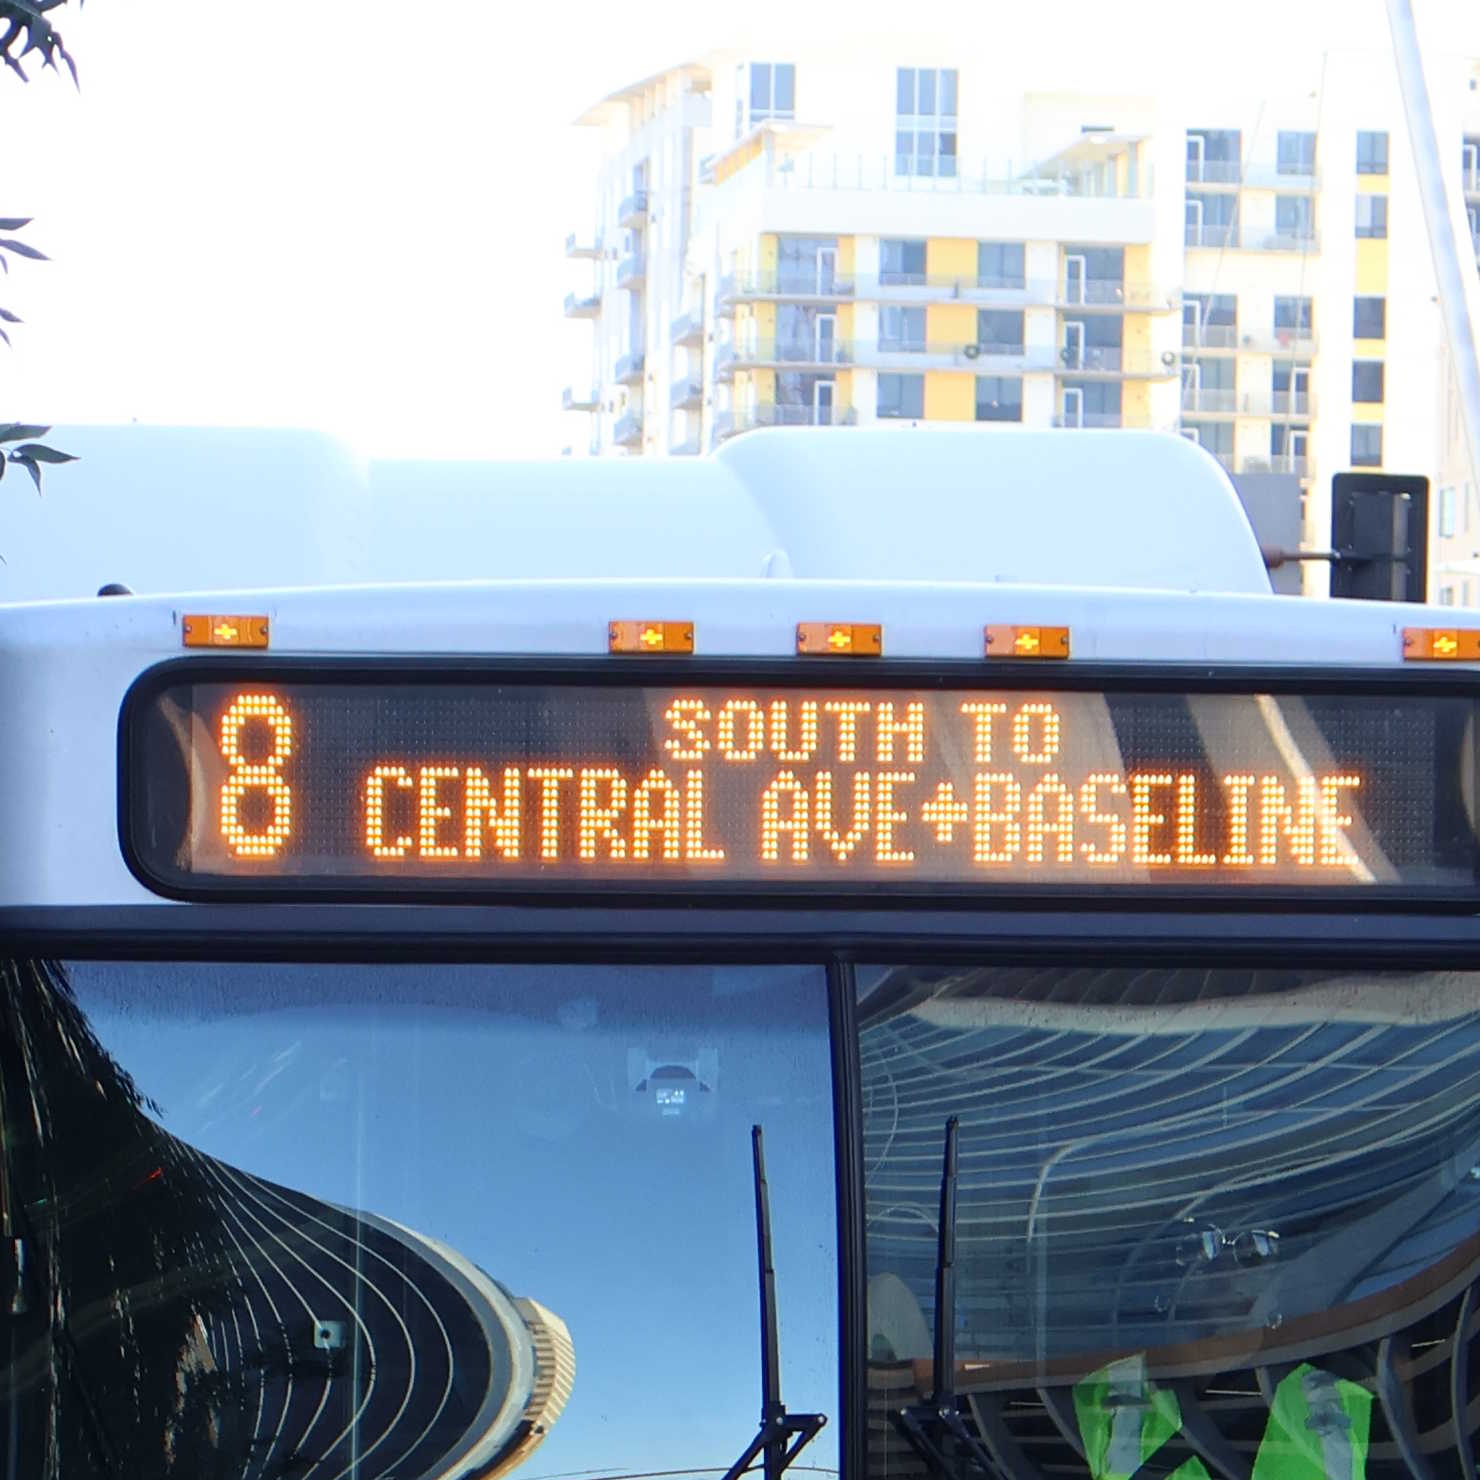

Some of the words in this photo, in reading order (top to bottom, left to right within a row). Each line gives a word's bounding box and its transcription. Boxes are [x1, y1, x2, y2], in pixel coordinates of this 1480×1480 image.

[221, 694, 292, 857] 8
[666, 700, 924, 762] SOUTH
[961, 703, 1059, 763] TO
[366, 766, 725, 859] CENTRAL
[762, 770, 1361, 866] AVE+BASELINE
